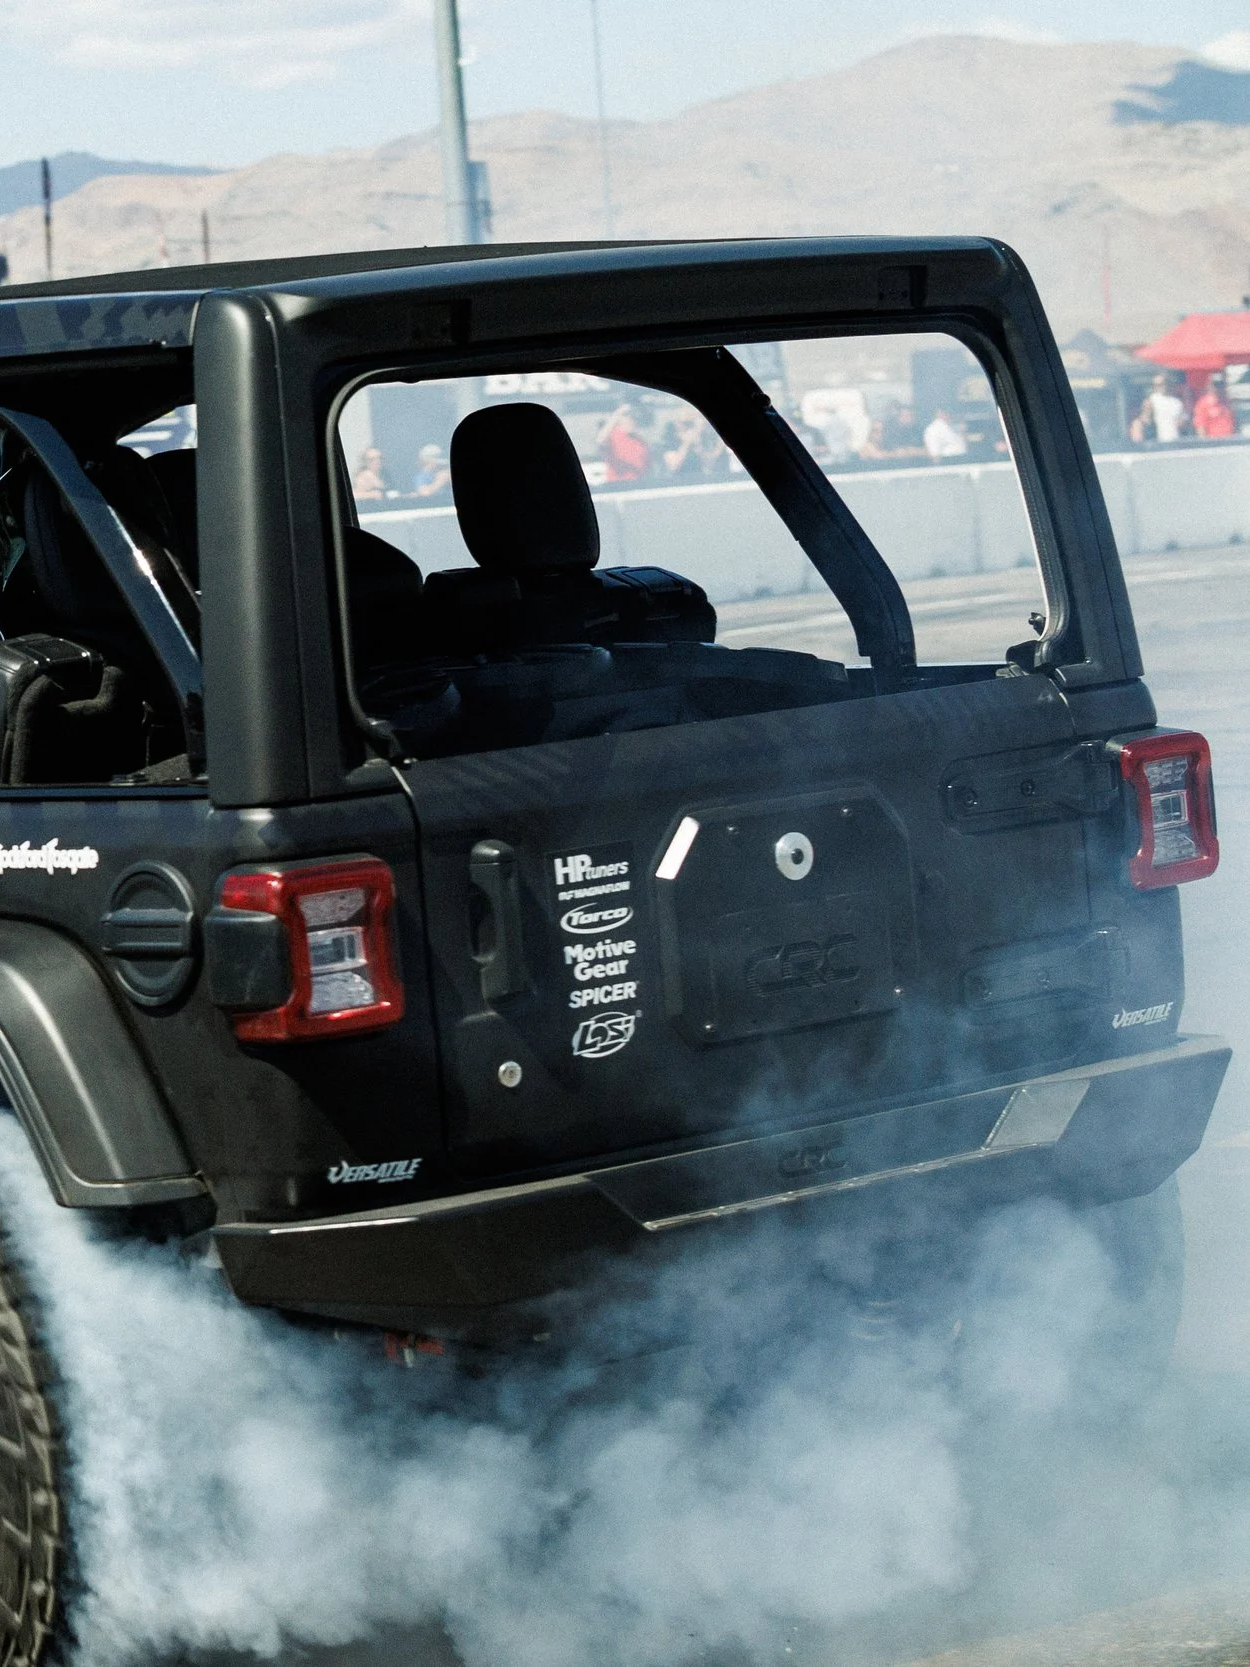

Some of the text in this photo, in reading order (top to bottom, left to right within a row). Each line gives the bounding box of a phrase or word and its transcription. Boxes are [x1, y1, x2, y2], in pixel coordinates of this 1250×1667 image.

[569, 907, 629, 926] Torco
[564, 939, 637, 965] Motive
[573, 960, 630, 982] Gear
[568, 981, 638, 1009] SPICER
[328, 1158, 423, 1184] VERSATILE
